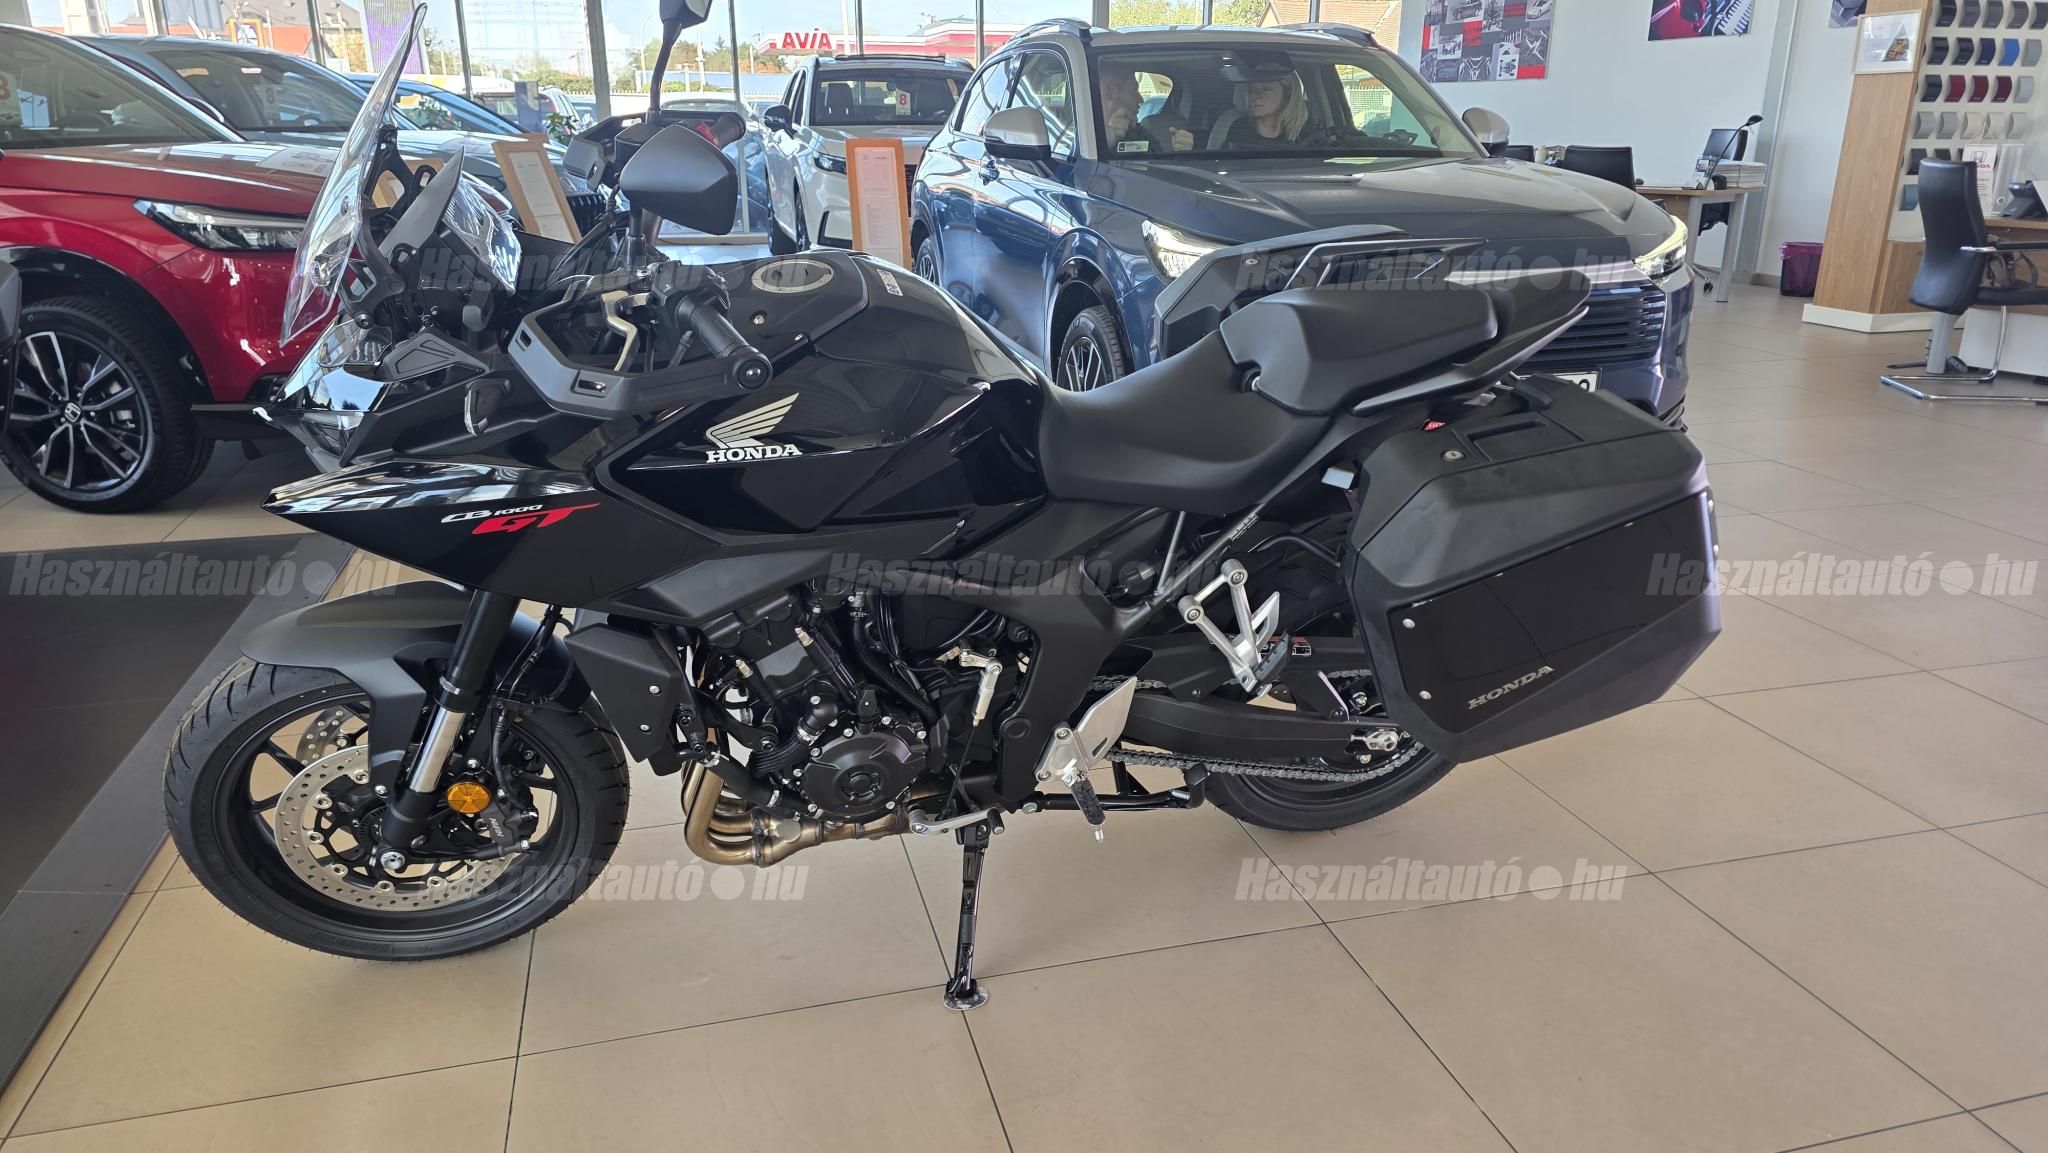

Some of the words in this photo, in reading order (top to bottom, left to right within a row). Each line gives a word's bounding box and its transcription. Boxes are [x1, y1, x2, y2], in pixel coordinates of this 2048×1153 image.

[706, 444, 802, 463] HONDA
[472, 503, 600, 535] GT
[1467, 665, 1555, 710] HONDA
